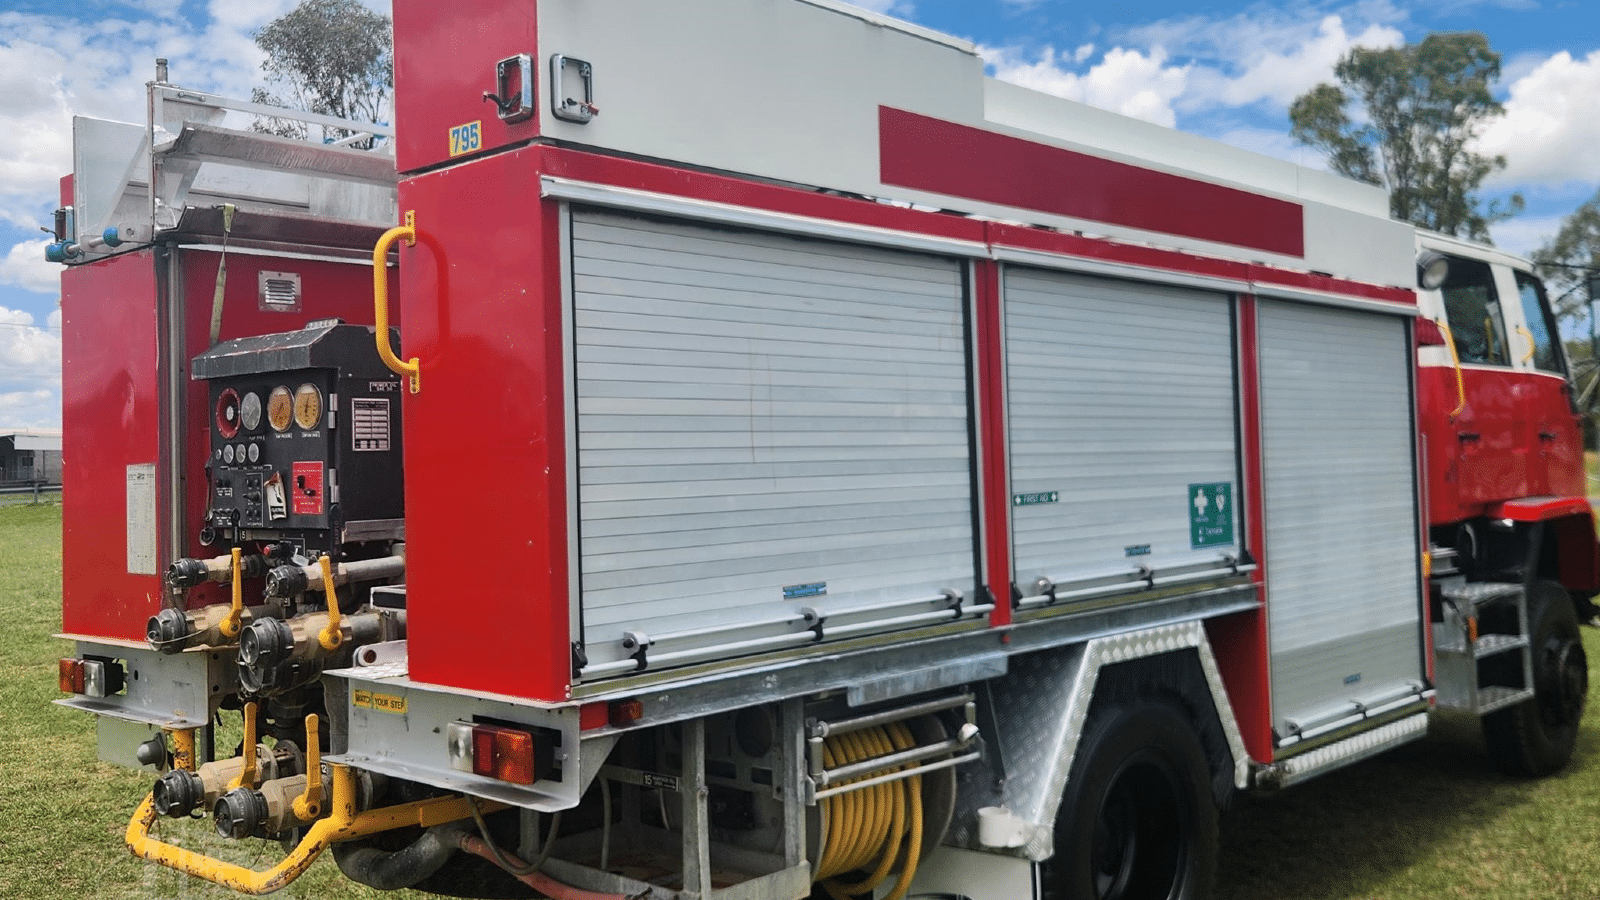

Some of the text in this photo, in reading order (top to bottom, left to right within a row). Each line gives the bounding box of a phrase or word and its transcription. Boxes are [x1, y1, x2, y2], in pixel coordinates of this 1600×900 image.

[452, 123, 478, 153] 795
[1023, 492, 1049, 503] FIRST AID
[374, 697, 389, 706] YOUR
[390, 700, 405, 710] STEP
